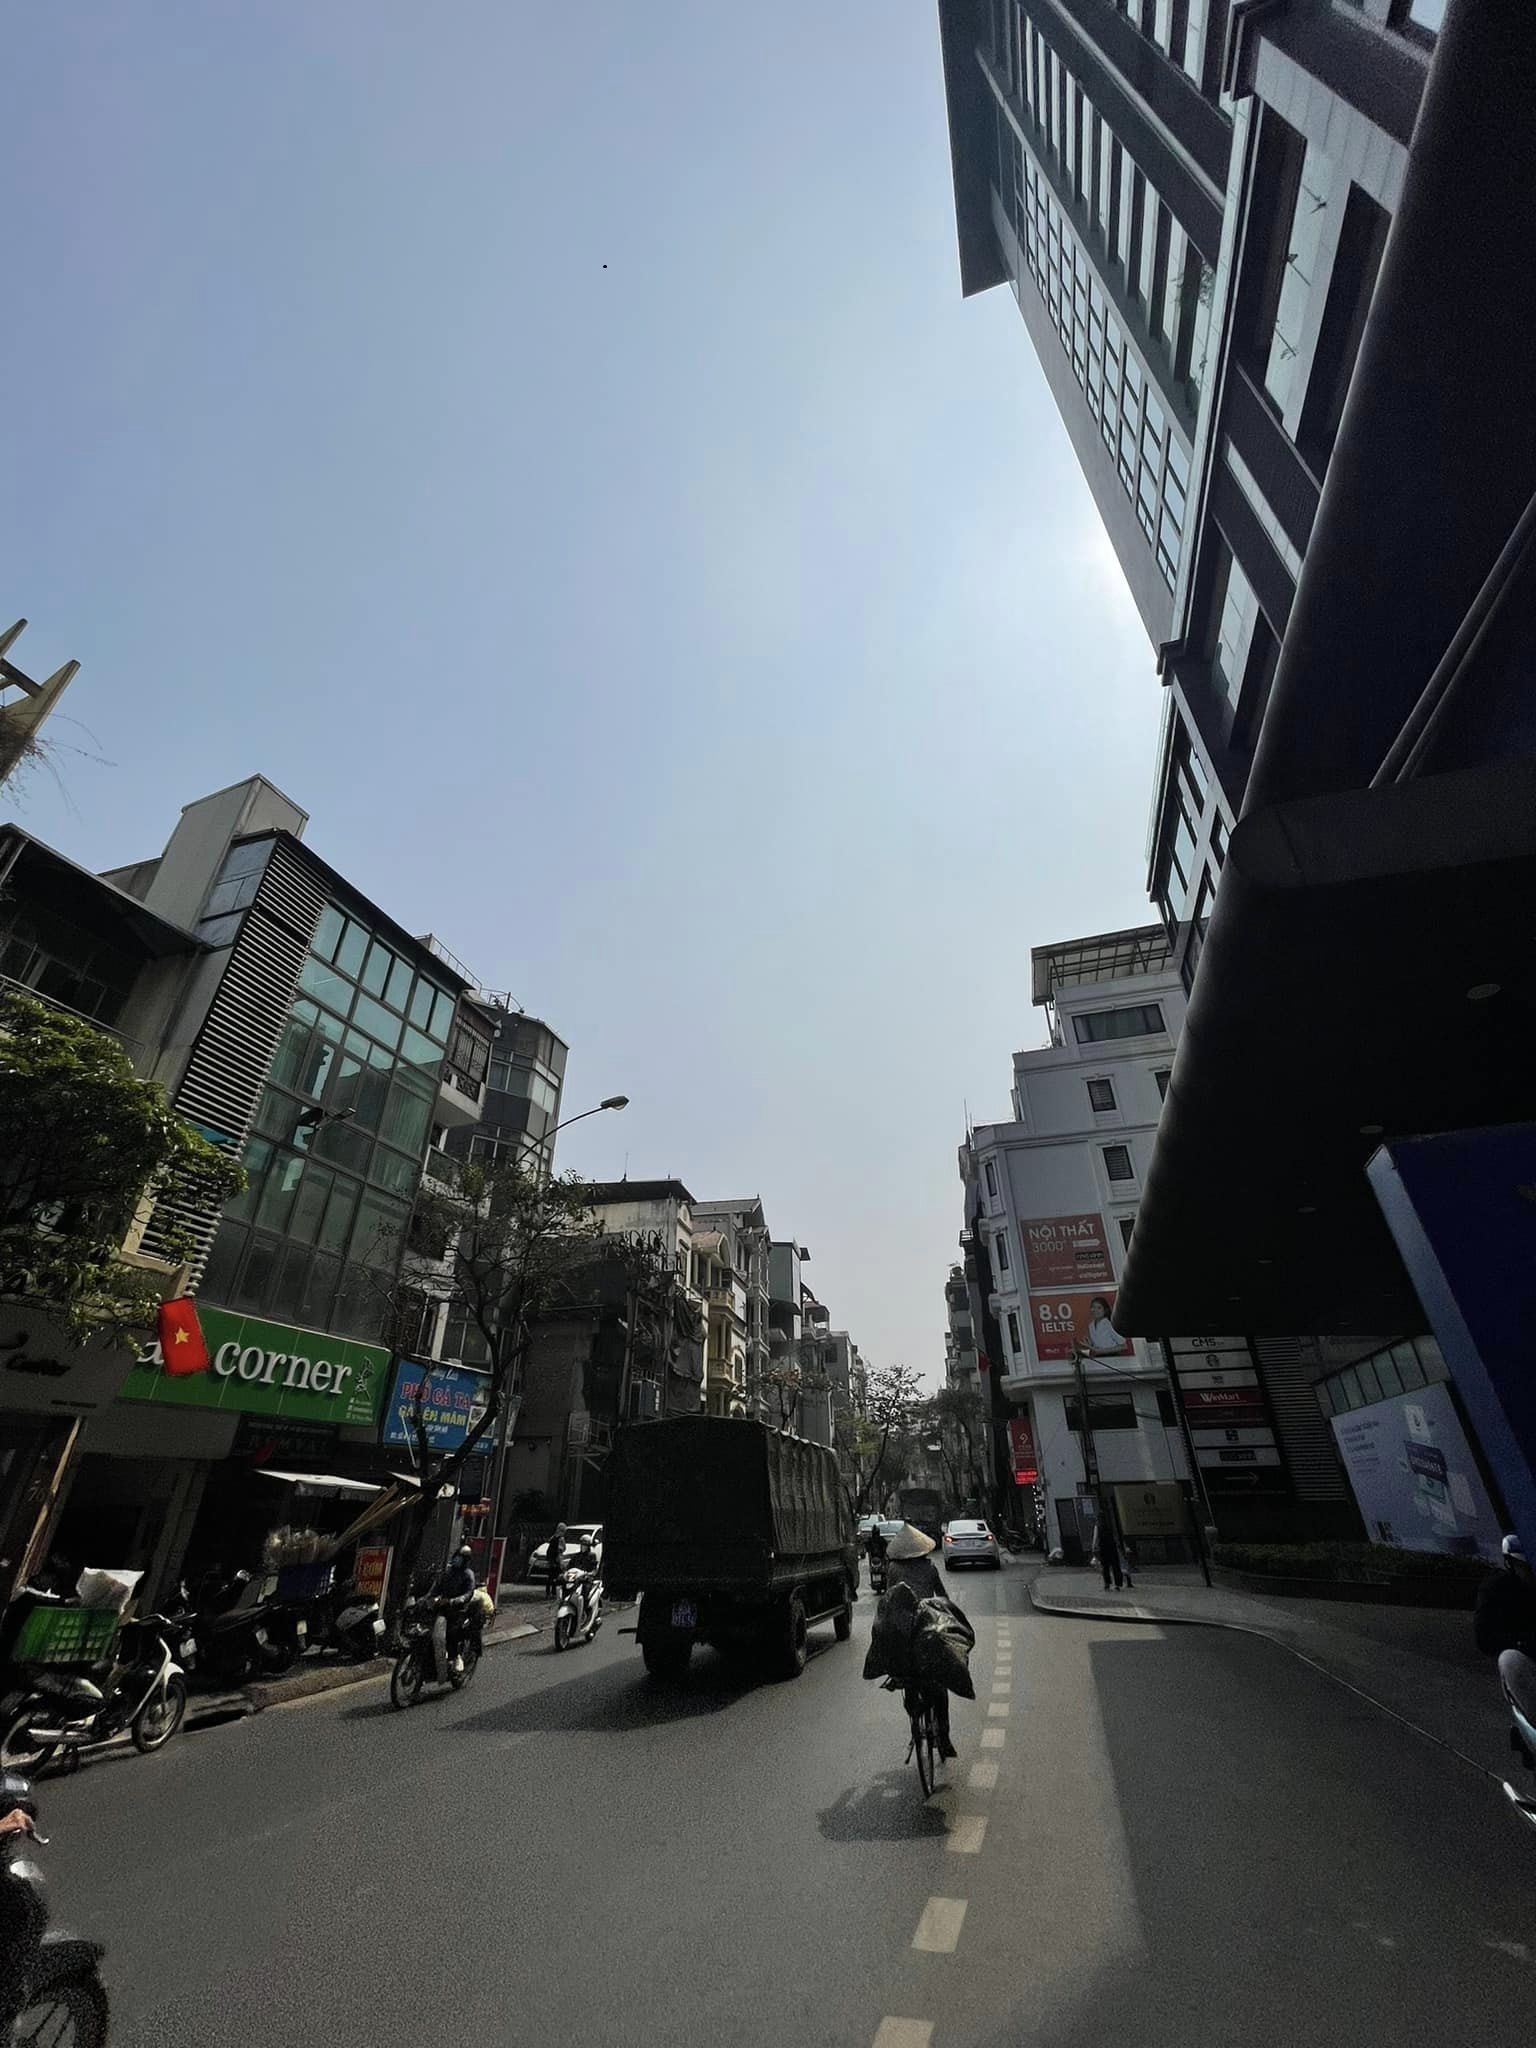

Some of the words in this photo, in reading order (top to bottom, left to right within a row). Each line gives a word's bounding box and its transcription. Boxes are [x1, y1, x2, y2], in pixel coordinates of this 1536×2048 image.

[1029, 1225, 1056, 1240] NỘI
[1060, 1219, 1094, 1237] THẤT
[1039, 1302, 1073, 1321] 8.0
[1041, 1321, 1075, 1333] IELTS
[1191, 1338, 1217, 1347] CMS
[215, 1341, 352, 1394] corner
[1200, 1391, 1241, 1404] WinMart
